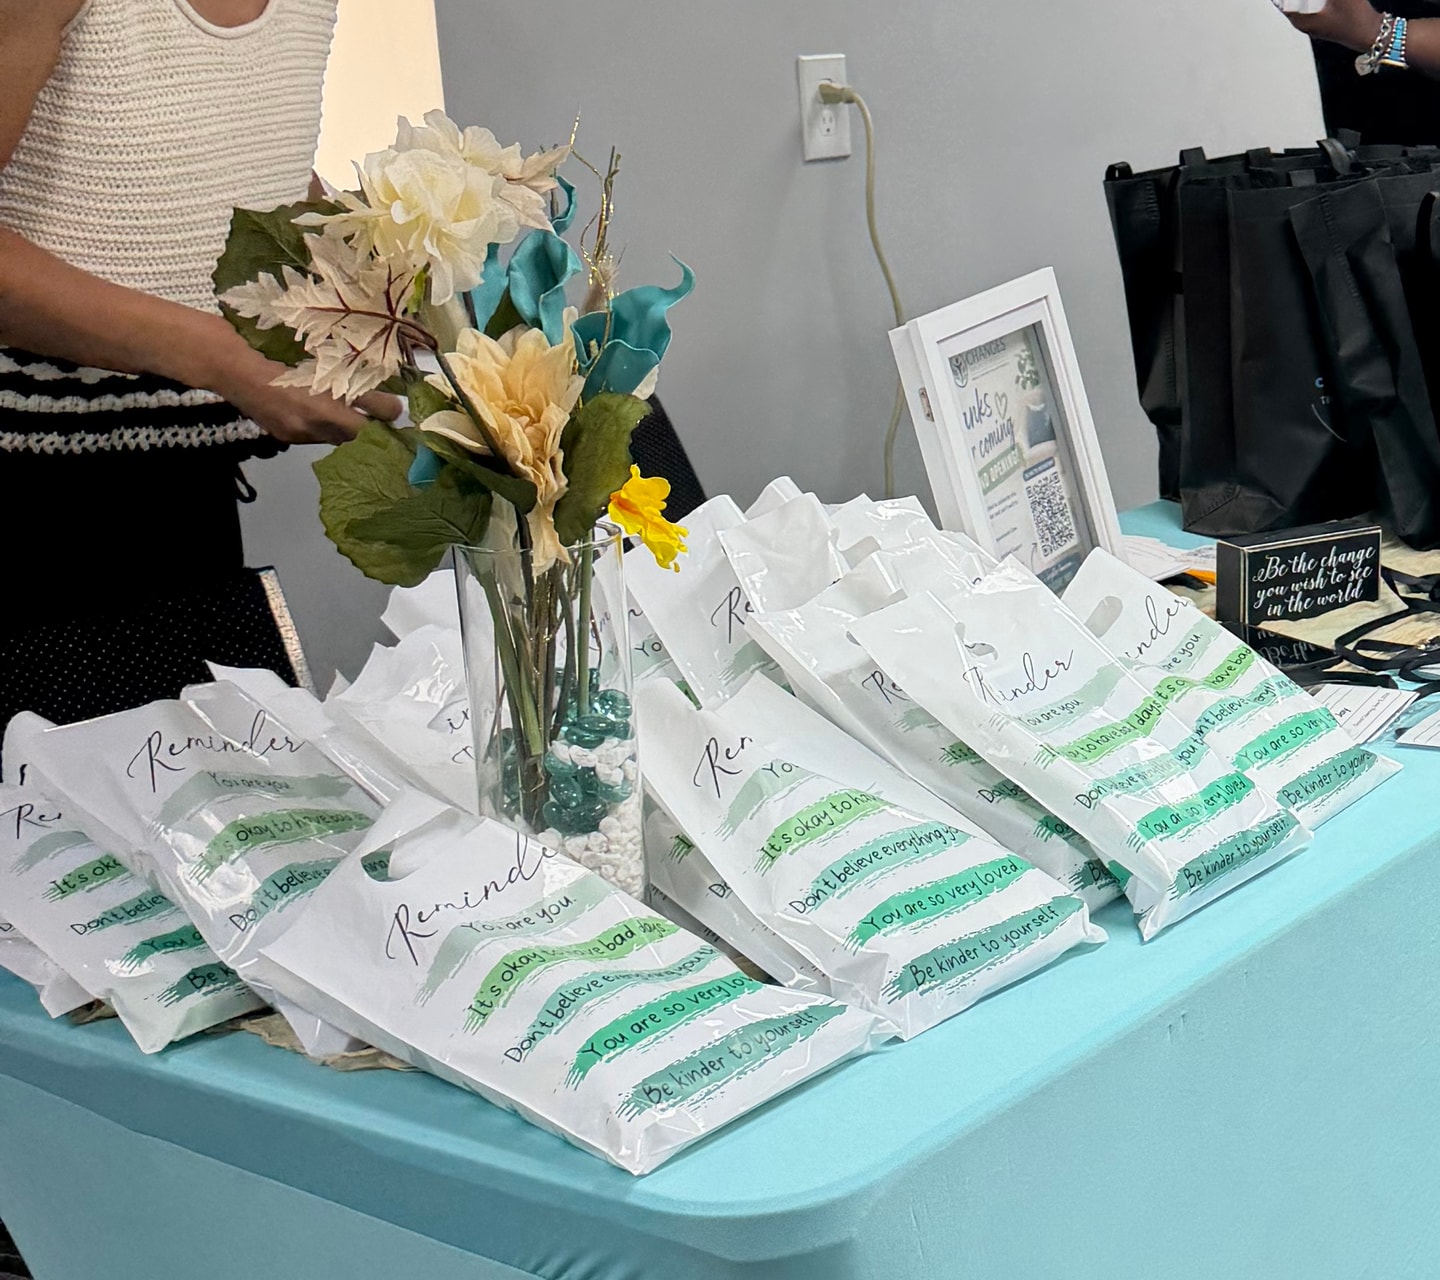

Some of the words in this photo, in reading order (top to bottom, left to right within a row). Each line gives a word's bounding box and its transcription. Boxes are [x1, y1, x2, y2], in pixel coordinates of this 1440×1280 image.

[979, 416, 1016, 458] coming
[1252, 554, 1288, 583] Be
[1288, 552, 1318, 574] the
[1321, 546, 1376, 570] change
[1253, 585, 1289, 610] you
[1291, 568, 1328, 592] wish
[1328, 567, 1346, 583] to
[1349, 565, 1373, 582] see
[1267, 601, 1286, 617] in
[1284, 592, 1314, 613] the
[1317, 579, 1363, 606] world
[1179, 633, 1203, 658] you.
[1043, 709, 1058, 721] are
[1084, 741, 1097, 753] to
[1097, 729, 1122, 749] have
[1137, 701, 1162, 726] days
[127, 709, 305, 793] Reminder
[1175, 744, 1197, 765] you
[1241, 747, 1269, 765] You
[1269, 734, 1289, 750] are
[1289, 727, 1304, 741] so
[1283, 788, 1302, 805] Be
[1304, 770, 1334, 797] kinder
[1334, 763, 1348, 777] to
[236, 823, 276, 842] okay
[272, 820, 293, 833] to
[760, 833, 793, 860] It's
[794, 809, 834, 836] okay
[832, 795, 852, 814] to
[1141, 819, 1168, 836] You
[50, 873, 88, 895] It's
[789, 880, 837, 914] Don't
[833, 849, 883, 883] believe
[882, 825, 948, 856] everything
[1184, 866, 1202, 888] Be
[1203, 851, 1235, 874] kinder
[1238, 844, 1251, 857] to
[385, 832, 557, 966] Reminde
[506, 915, 535, 931] are
[536, 896, 577, 924] you.
[862, 911, 902, 932] You
[904, 899, 927, 915] are
[929, 893, 946, 906] so
[948, 879, 983, 903] very
[980, 858, 1022, 885] loved.
[71, 910, 119, 935] Don't
[144, 938, 185, 951] You
[911, 964, 935, 986] Be
[938, 946, 980, 971] kinder
[983, 938, 999, 953] to
[187, 969, 222, 989] Be
[466, 985, 502, 1021] It's
[501, 948, 547, 983] okay
[600, 924, 636, 951] bad
[504, 1020, 555, 1063] Don't
[546, 979, 603, 1019] believe
[581, 1032, 628, 1058] You
[630, 1012, 662, 1033] are
[663, 1002, 685, 1016] so
[687, 983, 729, 1005] very
[643, 1081, 673, 1105] Be
[672, 1057, 725, 1088] kinder
[728, 1041, 753, 1060] to
